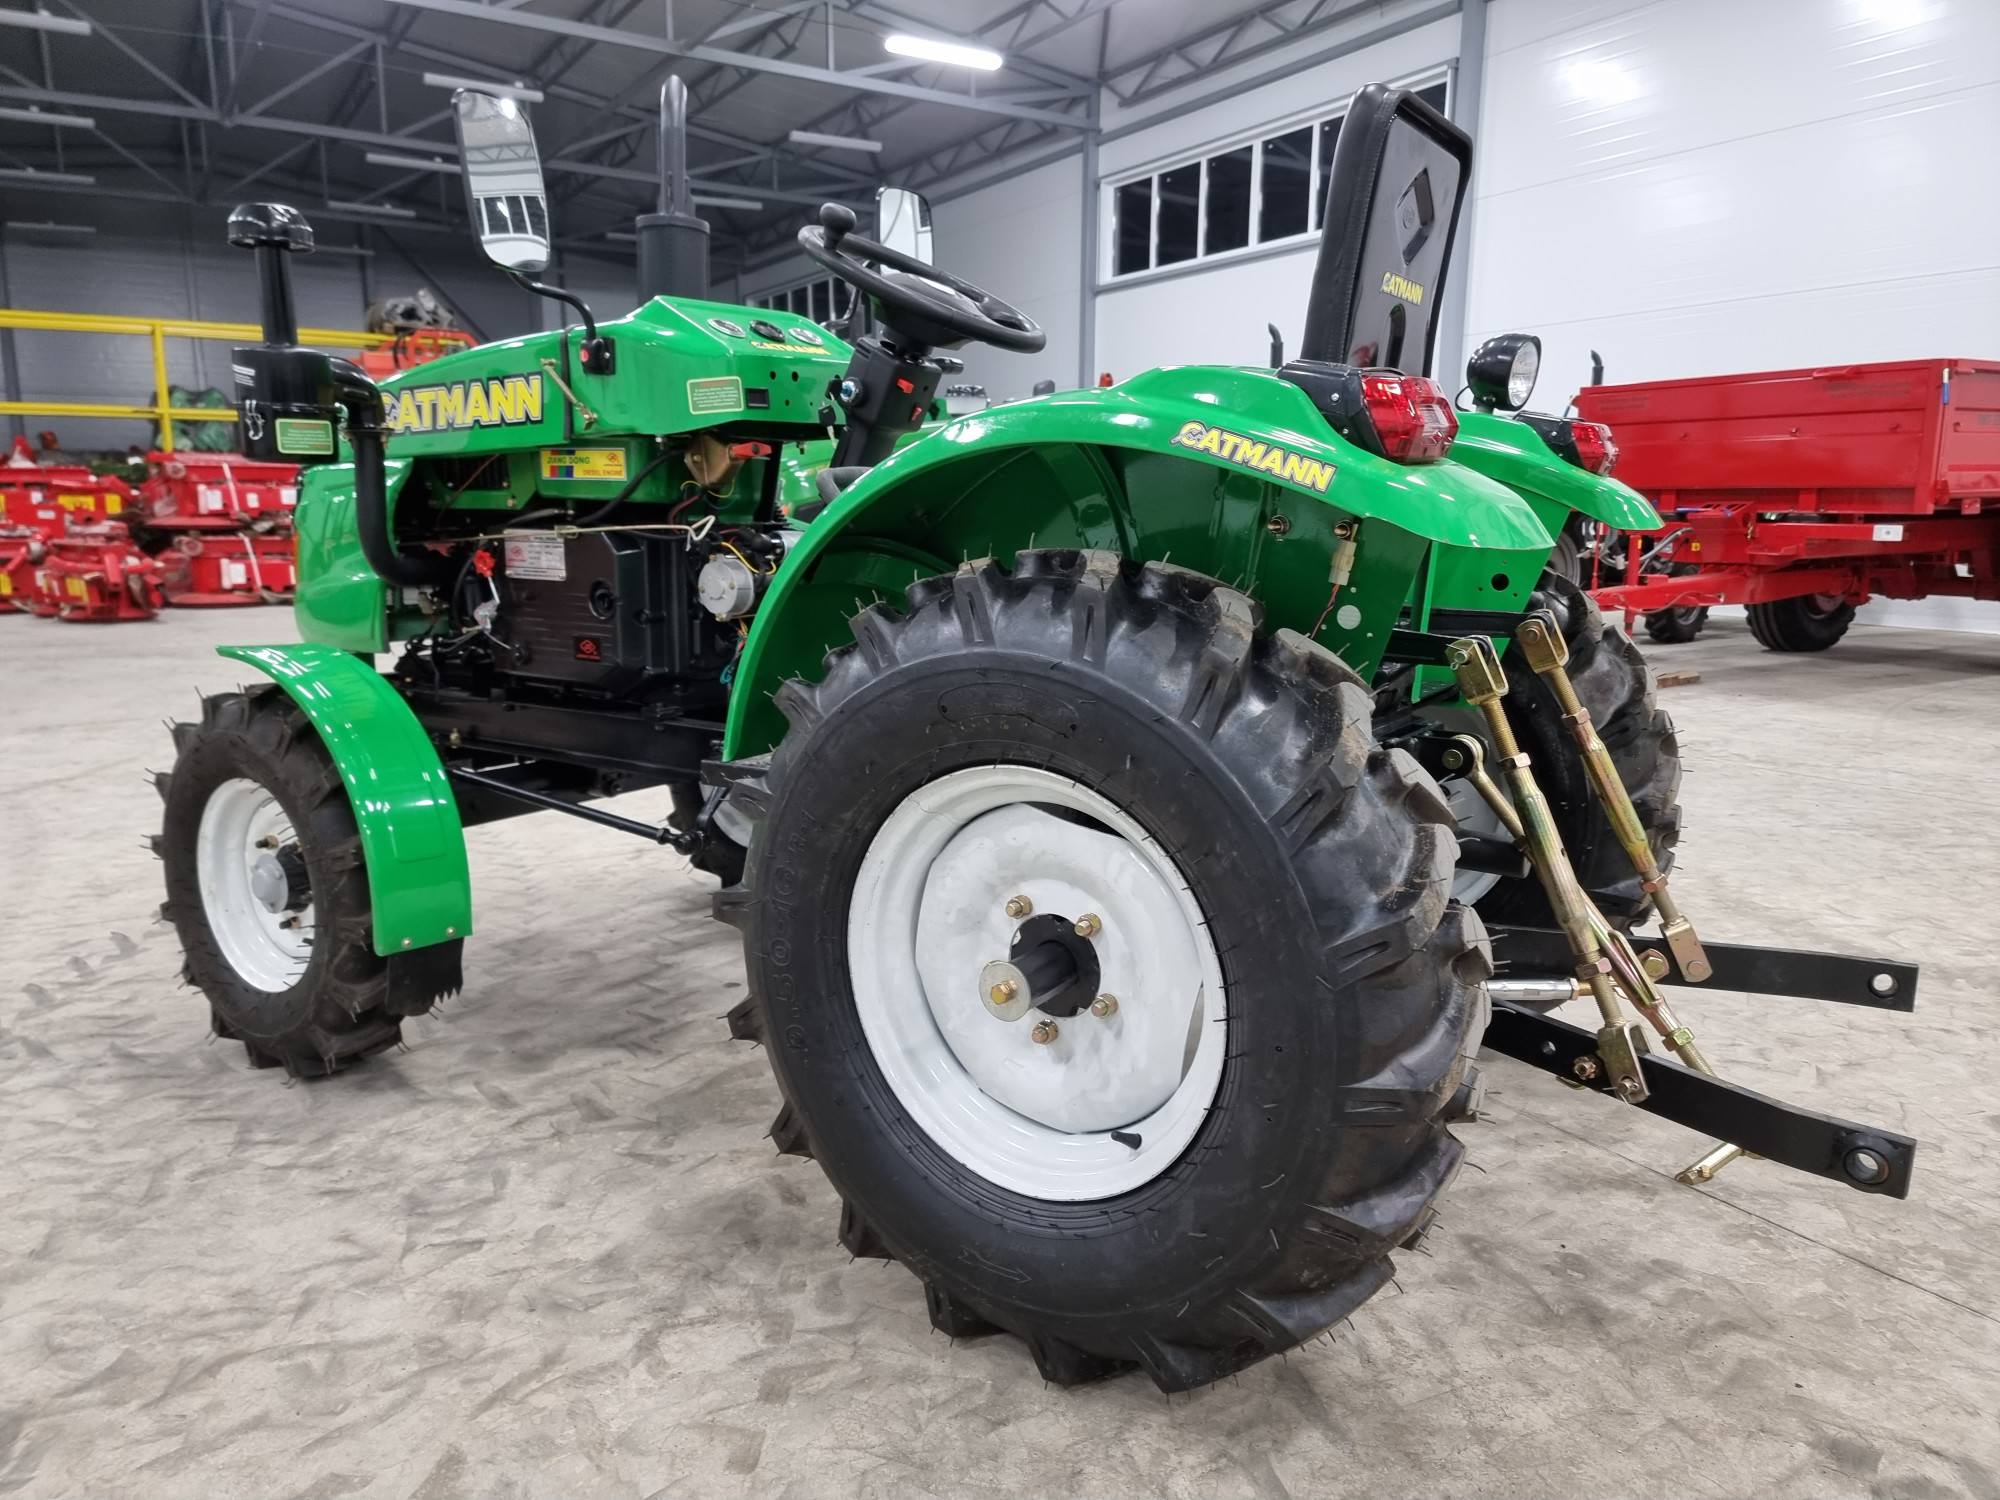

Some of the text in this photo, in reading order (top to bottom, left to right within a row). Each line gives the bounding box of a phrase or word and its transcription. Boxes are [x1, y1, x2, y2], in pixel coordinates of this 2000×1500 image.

[1381, 271, 1424, 306] CATMANN
[568, 456, 591, 465] DONG
[1174, 421, 1336, 492] CATMANN
